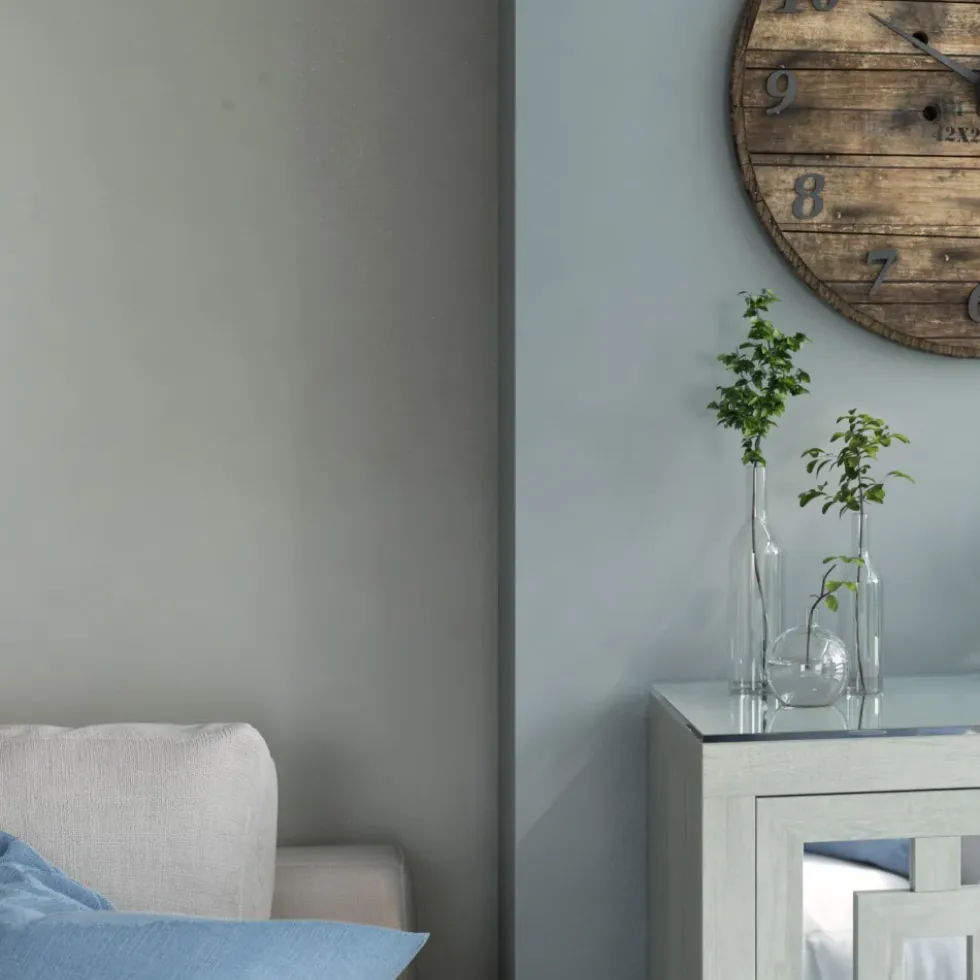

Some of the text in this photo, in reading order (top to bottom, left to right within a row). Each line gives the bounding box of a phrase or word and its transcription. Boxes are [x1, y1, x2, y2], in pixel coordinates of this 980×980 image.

[765, 70, 797, 115] 9
[791, 173, 825, 220] 8
[867, 250, 898, 296] 7
